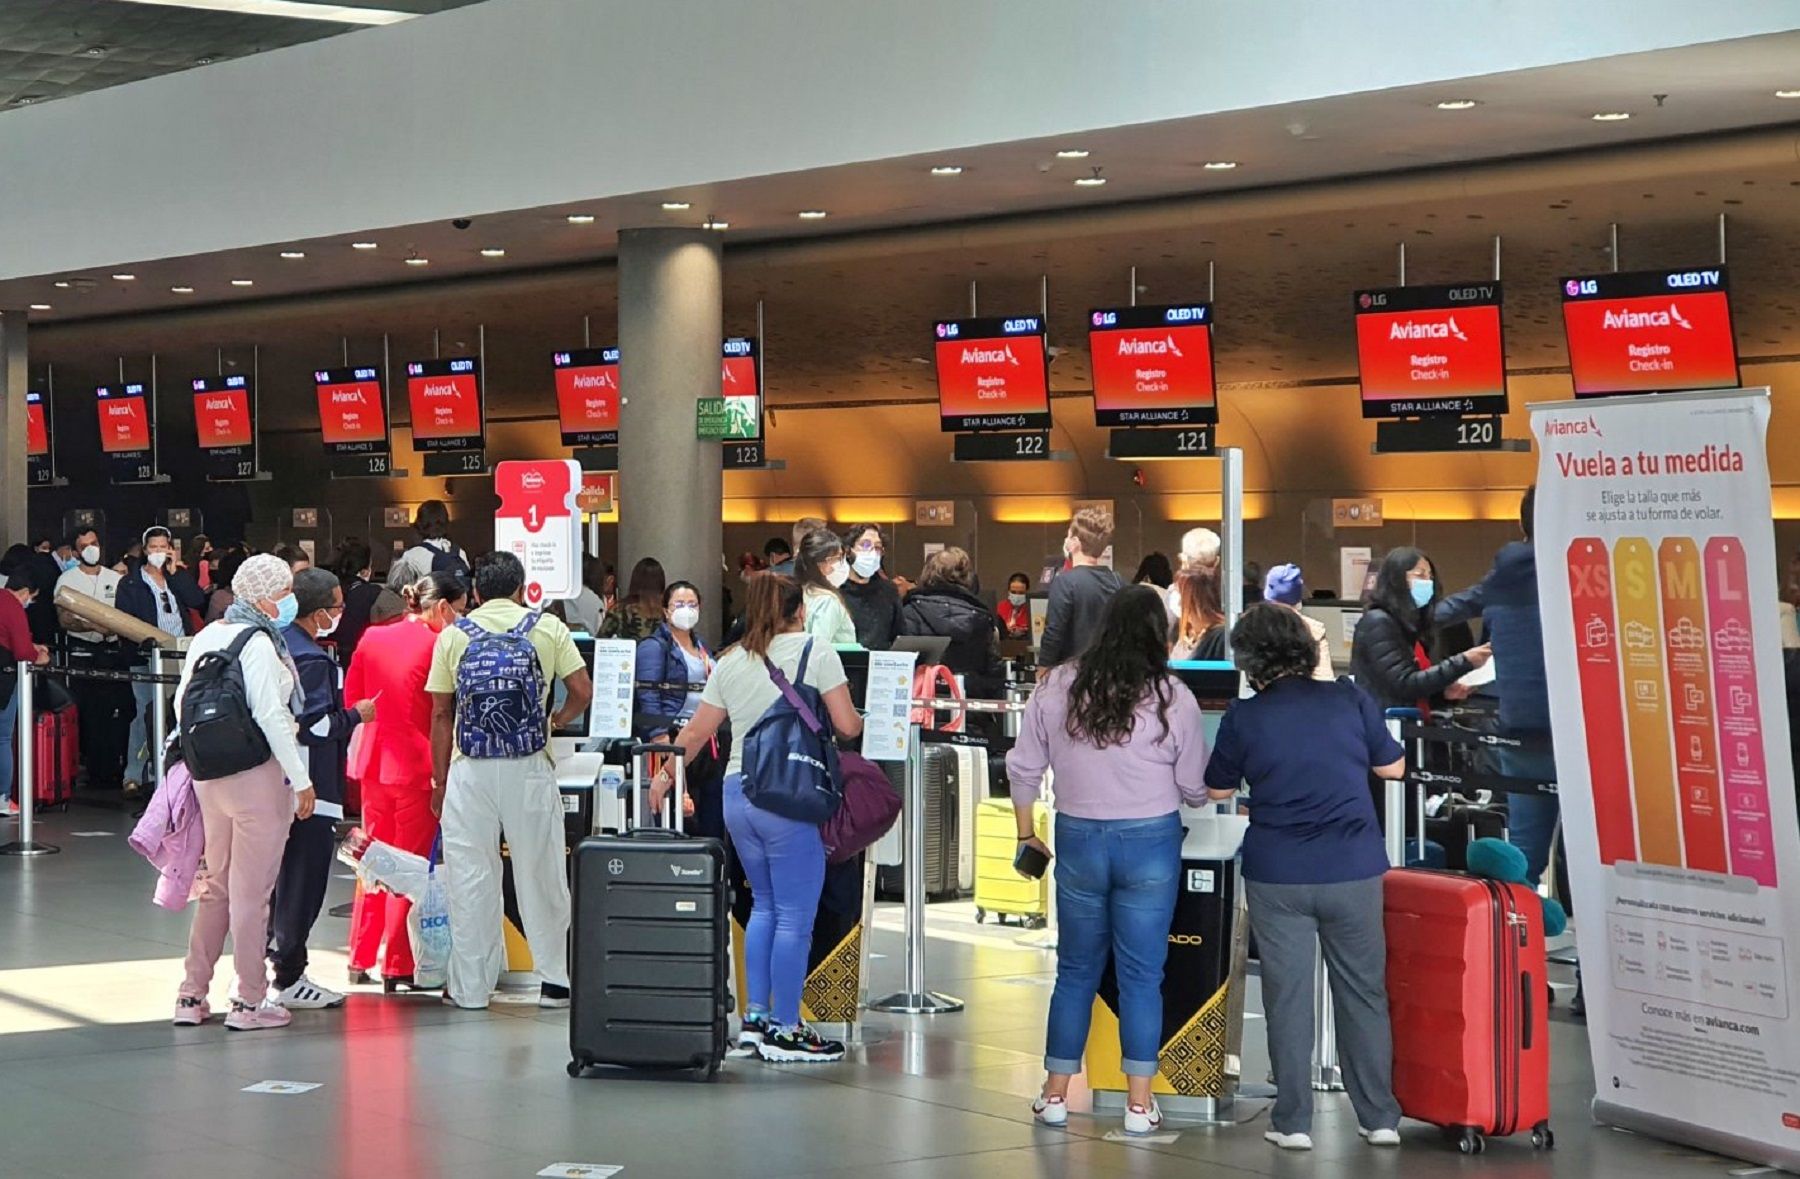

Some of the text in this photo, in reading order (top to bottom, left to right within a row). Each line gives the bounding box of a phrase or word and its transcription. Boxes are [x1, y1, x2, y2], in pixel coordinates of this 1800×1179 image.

[1667, 271, 1719, 287] OLED TV
[1449, 287, 1493, 301] OLED TV
[1580, 280, 1598, 294] LG
[1372, 294, 1387, 306] LG
[1103, 312, 1117, 325] LG
[1166, 308, 1205, 321] OLED TV
[1603, 309, 1671, 329] Avianca
[946, 324, 959, 335] LG
[1004, 319, 1038, 333] OLED TV
[1390, 321, 1449, 340] Avianca
[724, 342, 741, 353] OLED
[1118, 338, 1167, 356] Avianca
[1628, 344, 1671, 357] Registro
[961, 347, 1006, 364] Avianca
[1410, 354, 1448, 367] Registro
[1629, 359, 1674, 372] Check-in
[573, 374, 605, 388] Avianca
[1135, 369, 1166, 380] Registro
[1410, 369, 1449, 381] Check-in
[424, 383, 452, 398] Avianca
[1135, 381, 1169, 392] Check-in
[332, 389, 359, 403] Avianca
[1390, 401, 1461, 412] STAR ALLIANCE
[1119, 411, 1179, 420] STAR ALLIANCE
[1457, 423, 1493, 444] 120
[1545, 418, 1588, 437] Avianca
[1016, 436, 1043, 454] 122
[1177, 432, 1208, 451] 121
[736, 447, 758, 462] 123
[1556, 443, 1744, 478] Vuela a tu medida
[237, 462, 252, 475] 127
[368, 458, 386, 472] 126
[461, 456, 481, 470] 125
[1601, 489, 1702, 507] Elige la talla que más
[528, 504, 539, 527] 1
[1586, 506, 1724, 524] se ajusta a tu forma de volar.
[1570, 563, 1609, 599] XS
[1625, 560, 1648, 599] S
[1665, 560, 1698, 599] M
[1716, 559, 1743, 600] L
[1641, 1002, 1673, 1018] Conoce
[1675, 1010, 1692, 1023] más
[1705, 1015, 1760, 1037] avianca.com
